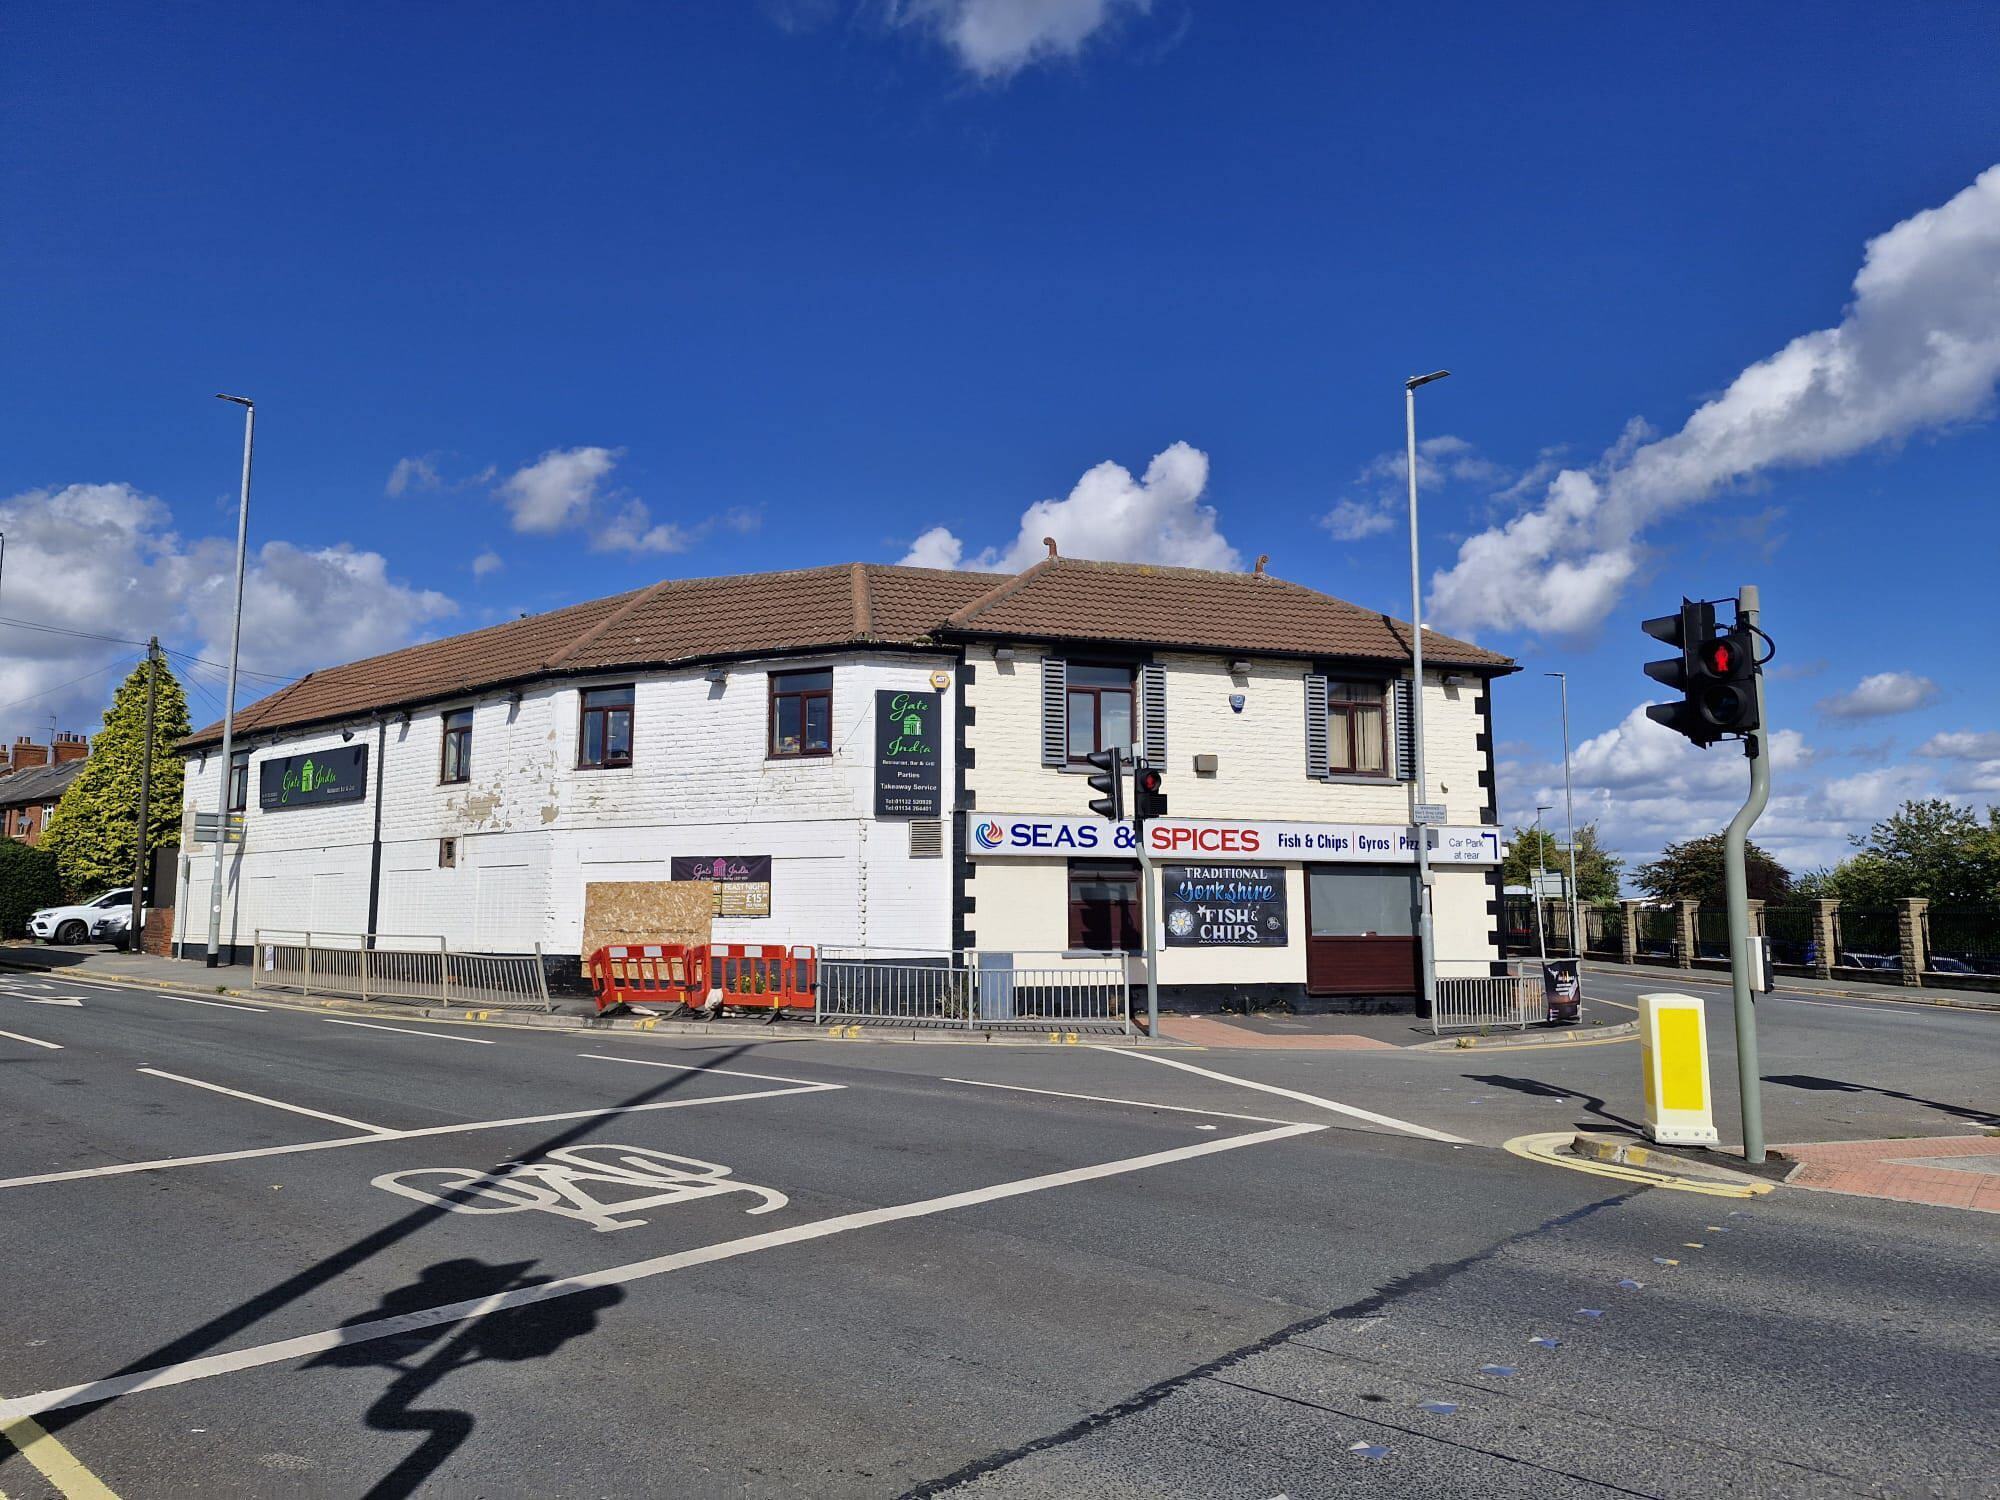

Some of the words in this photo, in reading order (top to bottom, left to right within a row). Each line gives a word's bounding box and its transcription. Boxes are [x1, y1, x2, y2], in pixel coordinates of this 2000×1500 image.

[890, 694, 928, 720] Gate
[887, 736, 931, 755] India
[282, 770, 300, 803] Gate
[314, 764, 336, 789] India
[880, 783, 911, 791] Takeaway
[1010, 823, 1098, 848] SEAS
[1113, 826, 1136, 848] &
[1151, 827, 1260, 852] SPICES
[1278, 833, 1300, 848] Fish
[1305, 834, 1313, 848] &
[1317, 835, 1348, 852] Chips
[1358, 835, 1390, 852] Gyros
[1400, 836, 1432, 851] Pizzs
[1448, 838, 1463, 847] Car
[1465, 838, 1484, 848] Park
[1454, 851, 1461, 859] at
[1464, 852, 1480, 860] rear
[692, 864, 711, 880] Gate
[1184, 867, 1268, 880] TRADITIONAL
[746, 893, 762, 903] £15
[1173, 880, 1276, 904] Yorkshire
[1204, 908, 1249, 923] FISH
[1251, 910, 1259, 921] &
[1200, 924, 1258, 940] CHIPS
